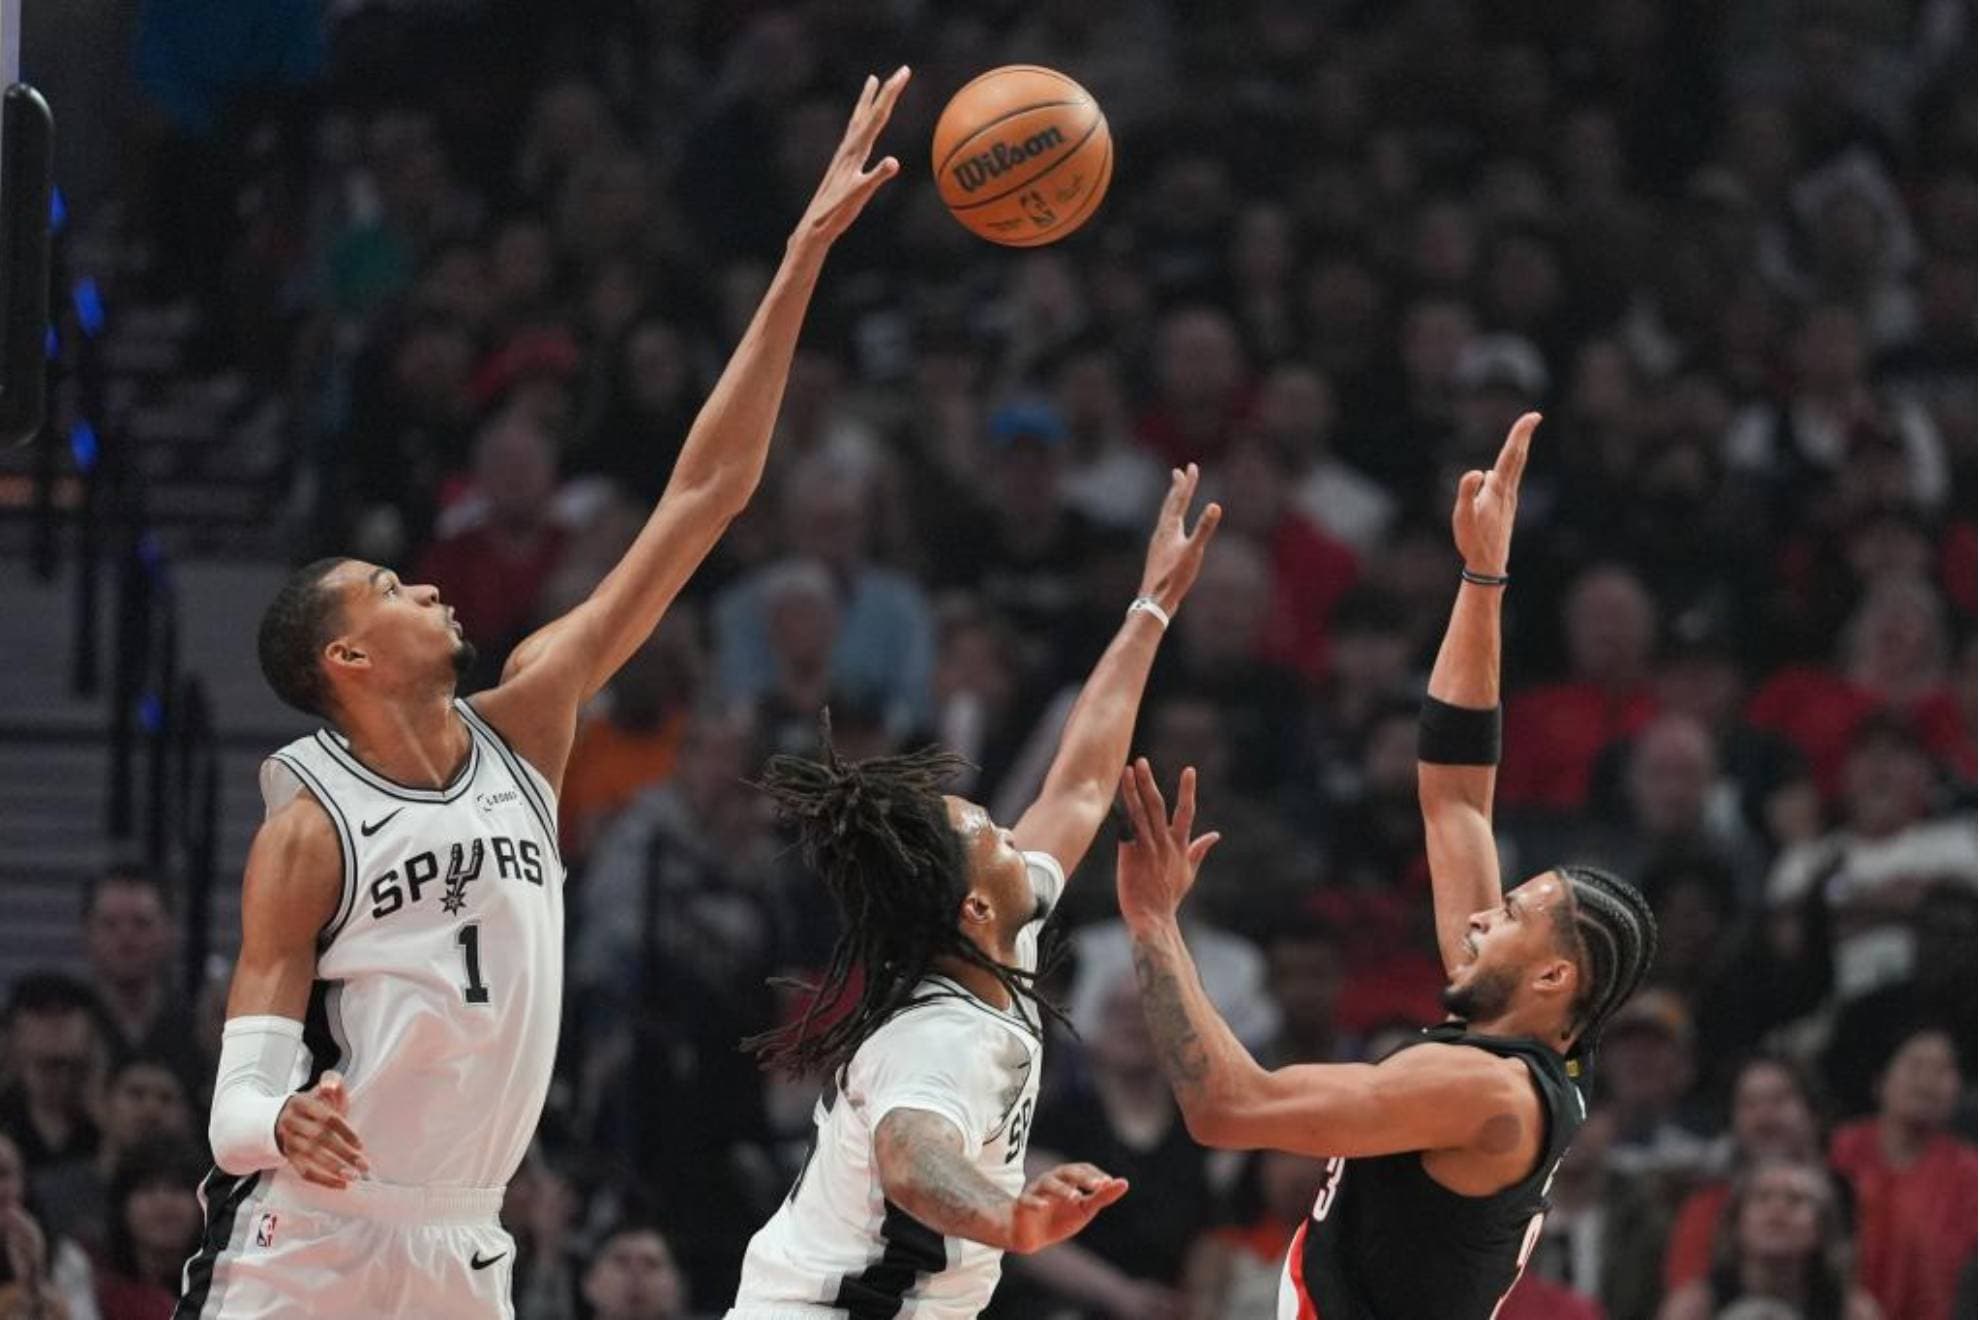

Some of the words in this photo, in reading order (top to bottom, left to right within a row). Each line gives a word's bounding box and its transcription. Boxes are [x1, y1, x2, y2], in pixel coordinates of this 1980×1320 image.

[953, 126, 1064, 192] Wilson
[370, 837, 543, 919] SPURS
[457, 923, 490, 1005] 1
